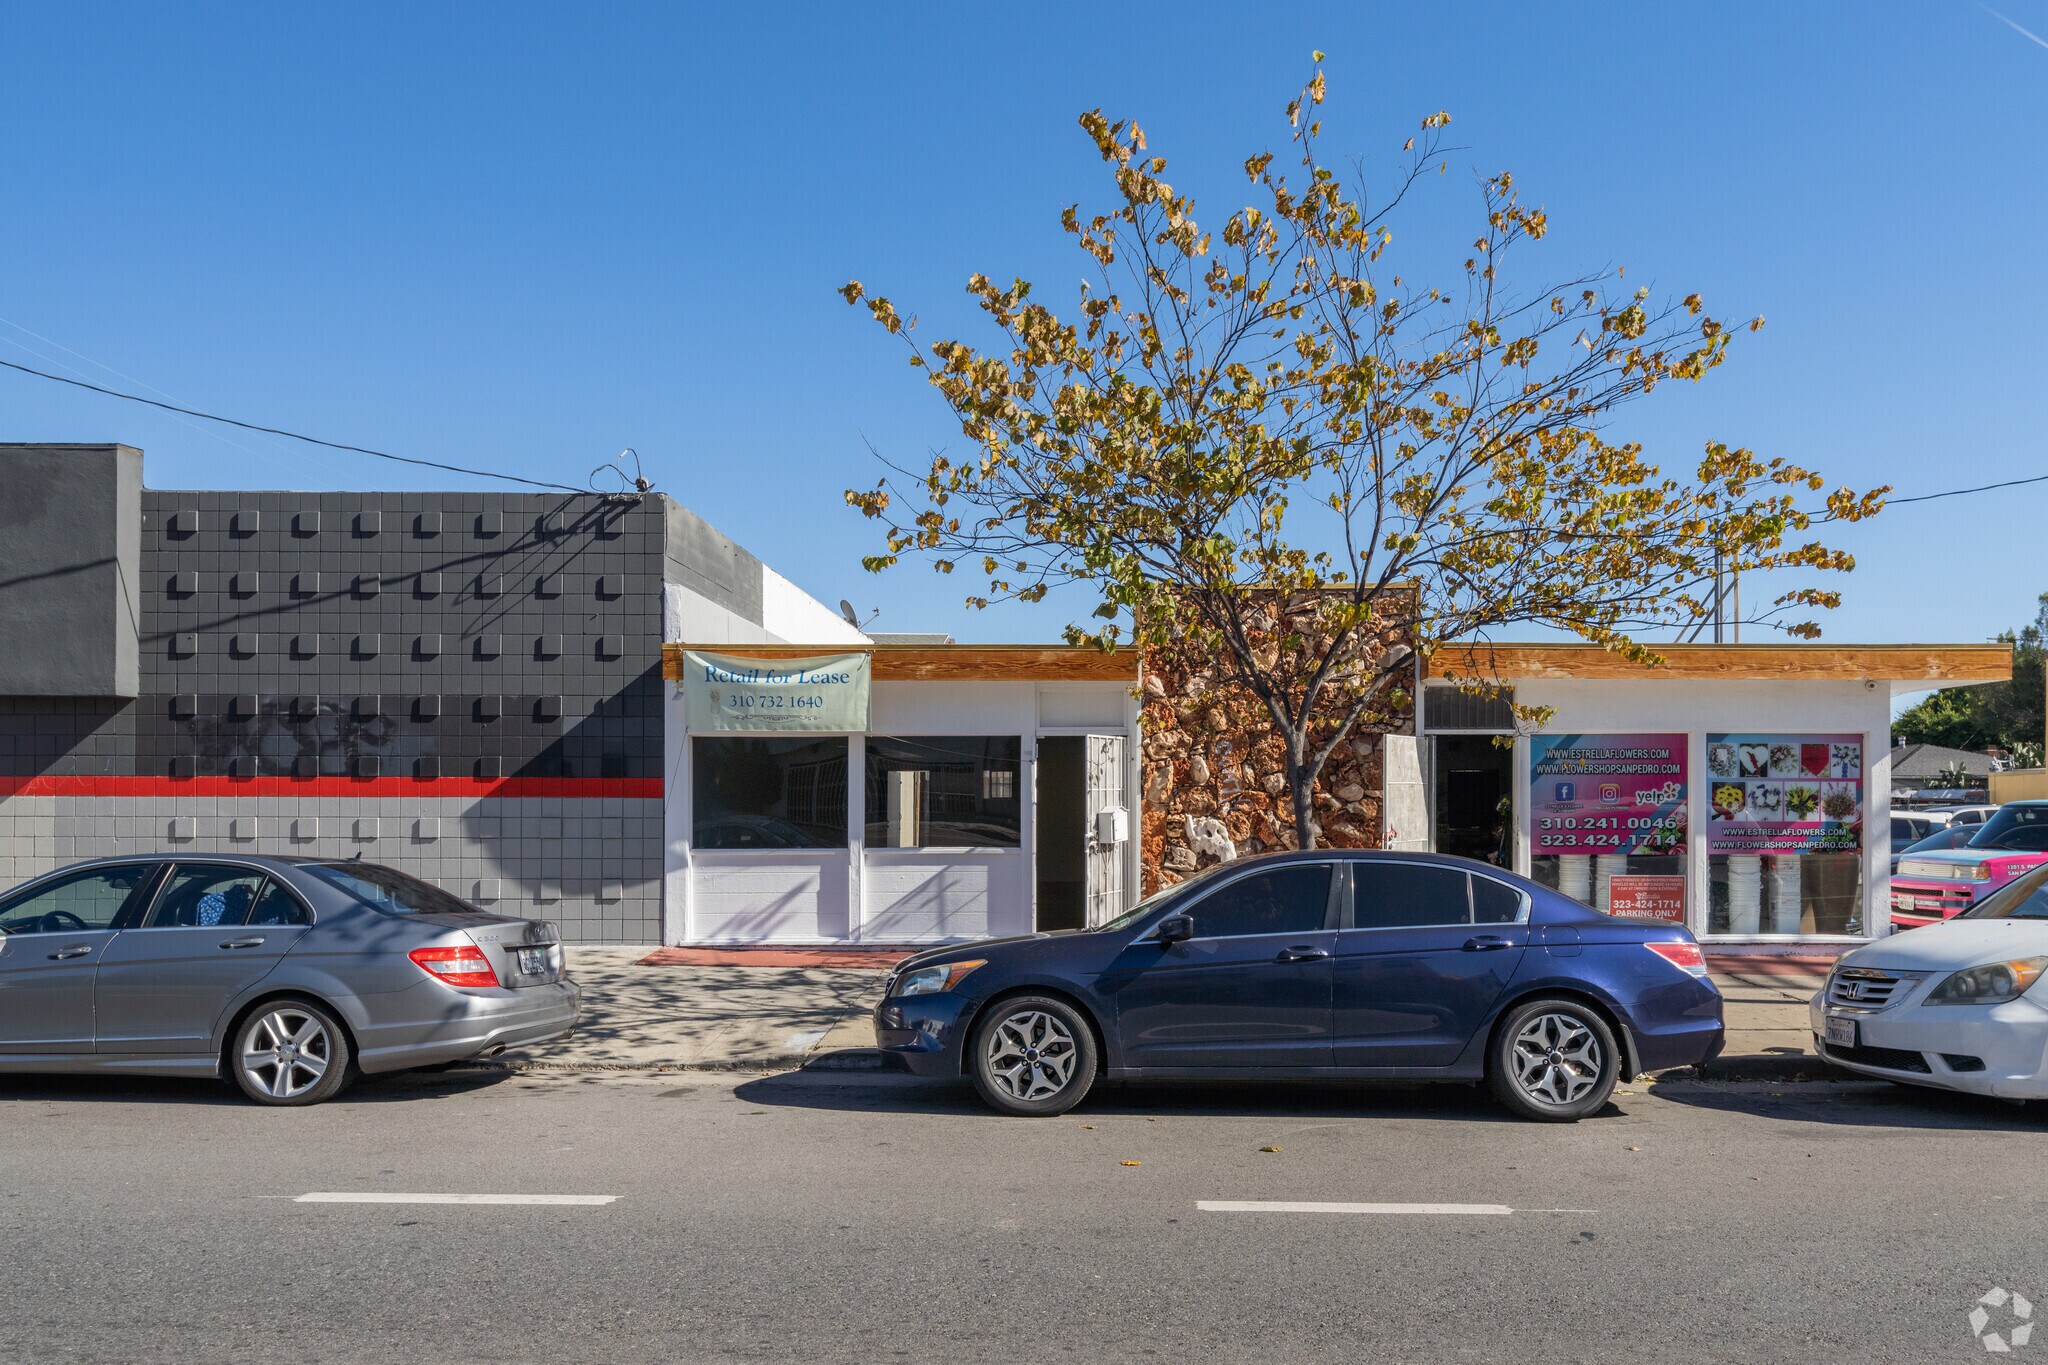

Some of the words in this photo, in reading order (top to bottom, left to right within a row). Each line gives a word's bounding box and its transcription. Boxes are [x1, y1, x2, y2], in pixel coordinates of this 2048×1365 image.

[704, 665, 759, 683] Retail
[765, 669, 792, 684] for
[798, 669, 850, 684] Lease
[729, 695, 755, 708] 310
[760, 695, 783, 708] 732
[790, 695, 823, 708] 1640
[1546, 749, 1669, 760] WWW.ESTRELLAFLOWERS.COM
[1536, 764, 1681, 775] WWW.FLOWERSHOPSANPEDRO.COM
[1636, 790, 1665, 805] yelp
[1540, 817, 1677, 830] 310.241.0046
[1722, 828, 1847, 837] WWW.ESTRELLAFLOWERS.COM
[1540, 834, 1677, 846] 323.424.1714
[1712, 841, 1857, 849] WWW.FLOWERSHOPSANPEDRO.COM
[1613, 900, 1681, 909] 323-424-1714
